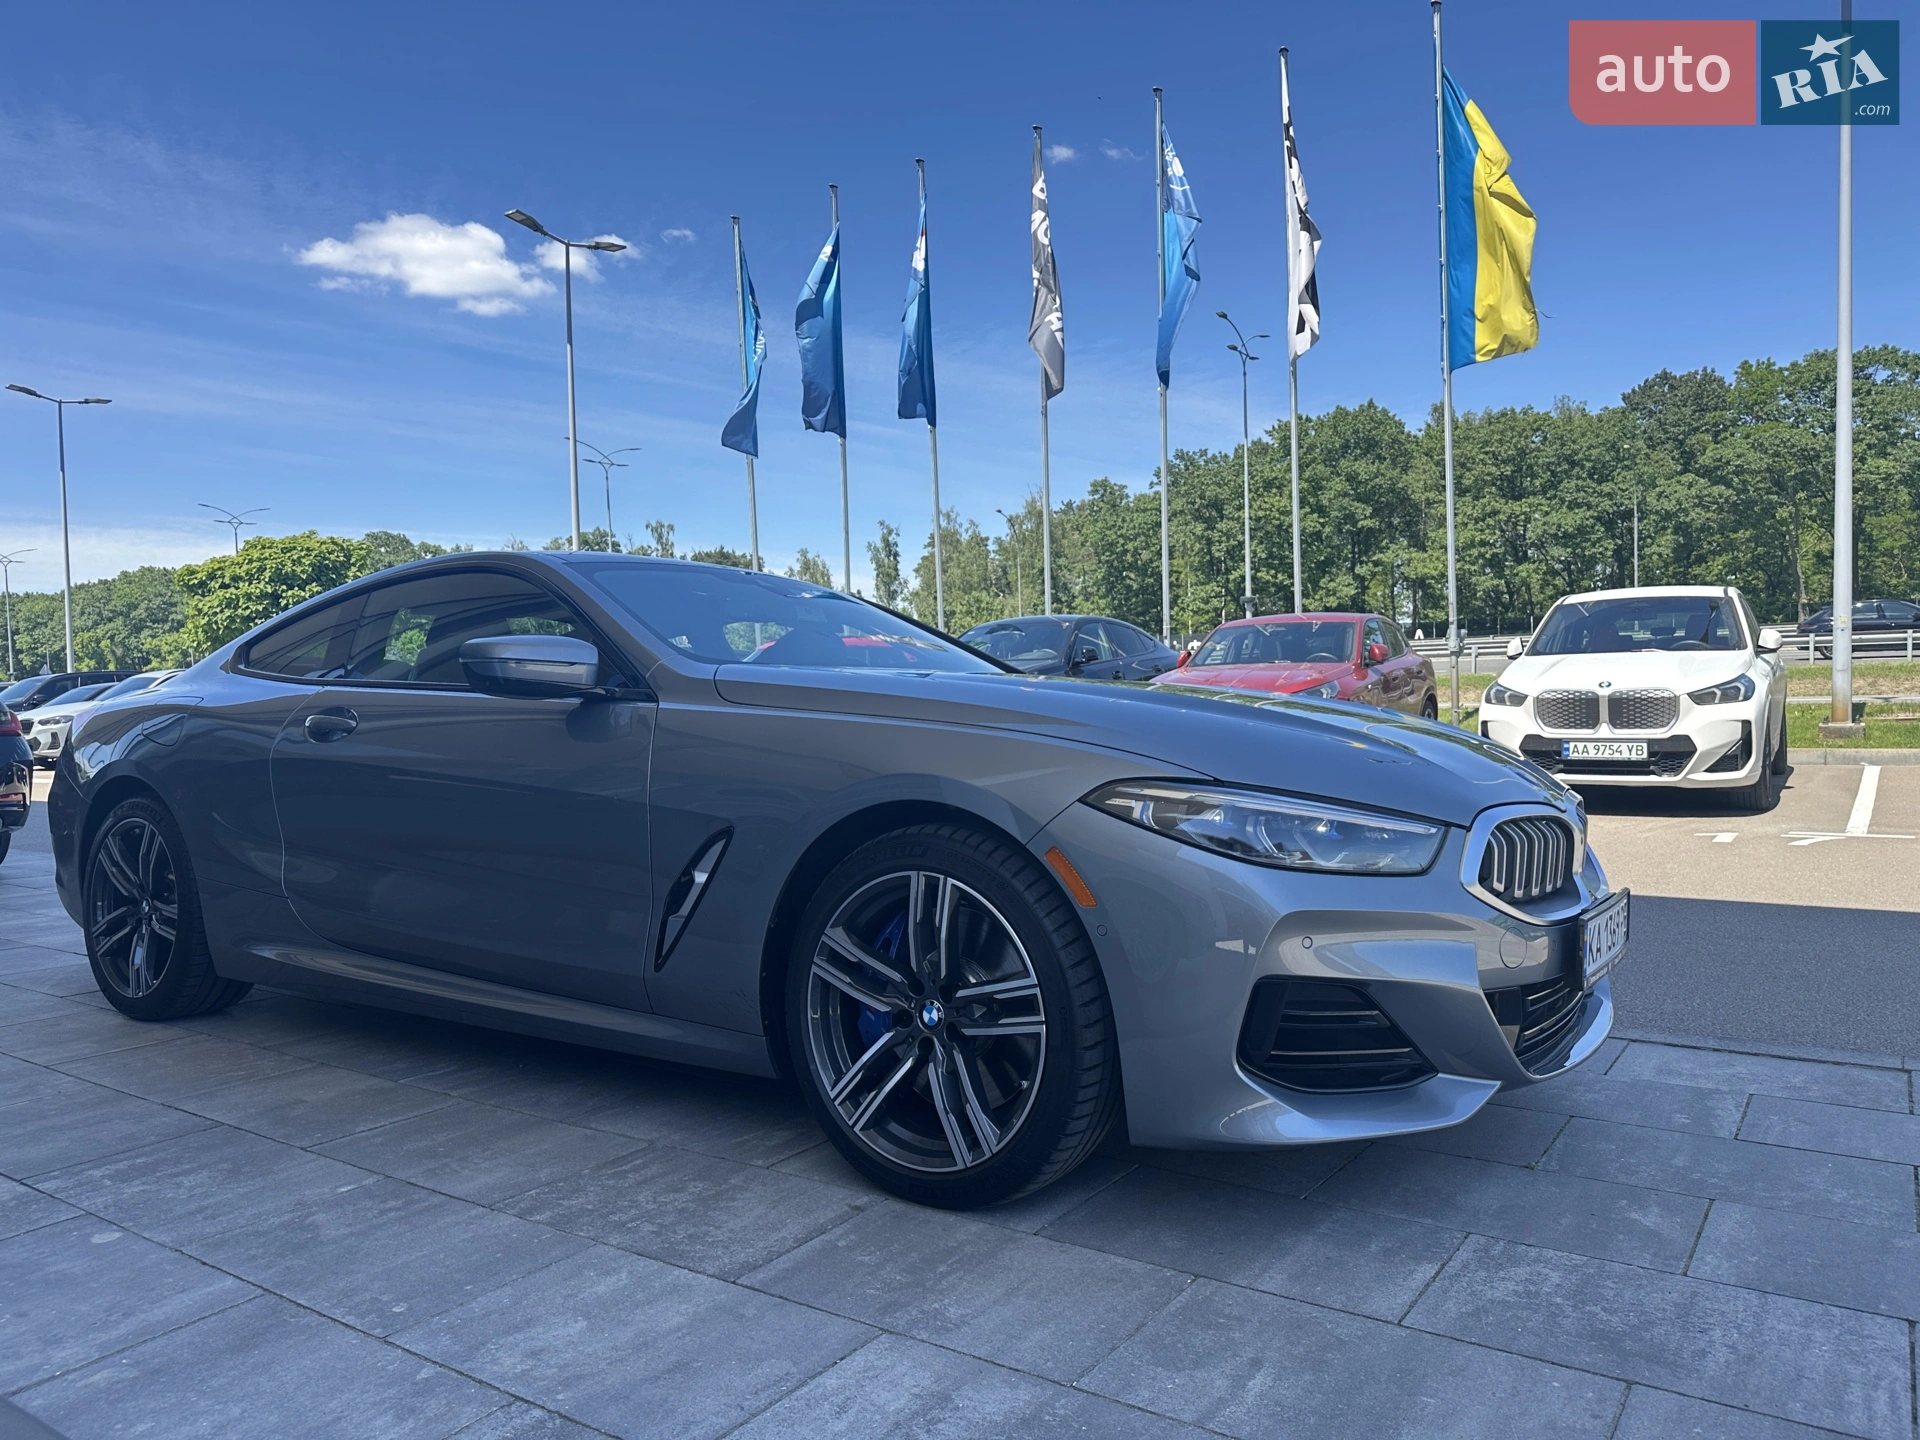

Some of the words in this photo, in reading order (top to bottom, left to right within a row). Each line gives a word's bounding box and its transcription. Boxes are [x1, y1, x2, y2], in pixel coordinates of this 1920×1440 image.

[1571, 744, 1590, 755] AA
[1593, 744, 1623, 756] 9754
[1626, 744, 1645, 756] YB
[1587, 922, 1602, 967] KA
